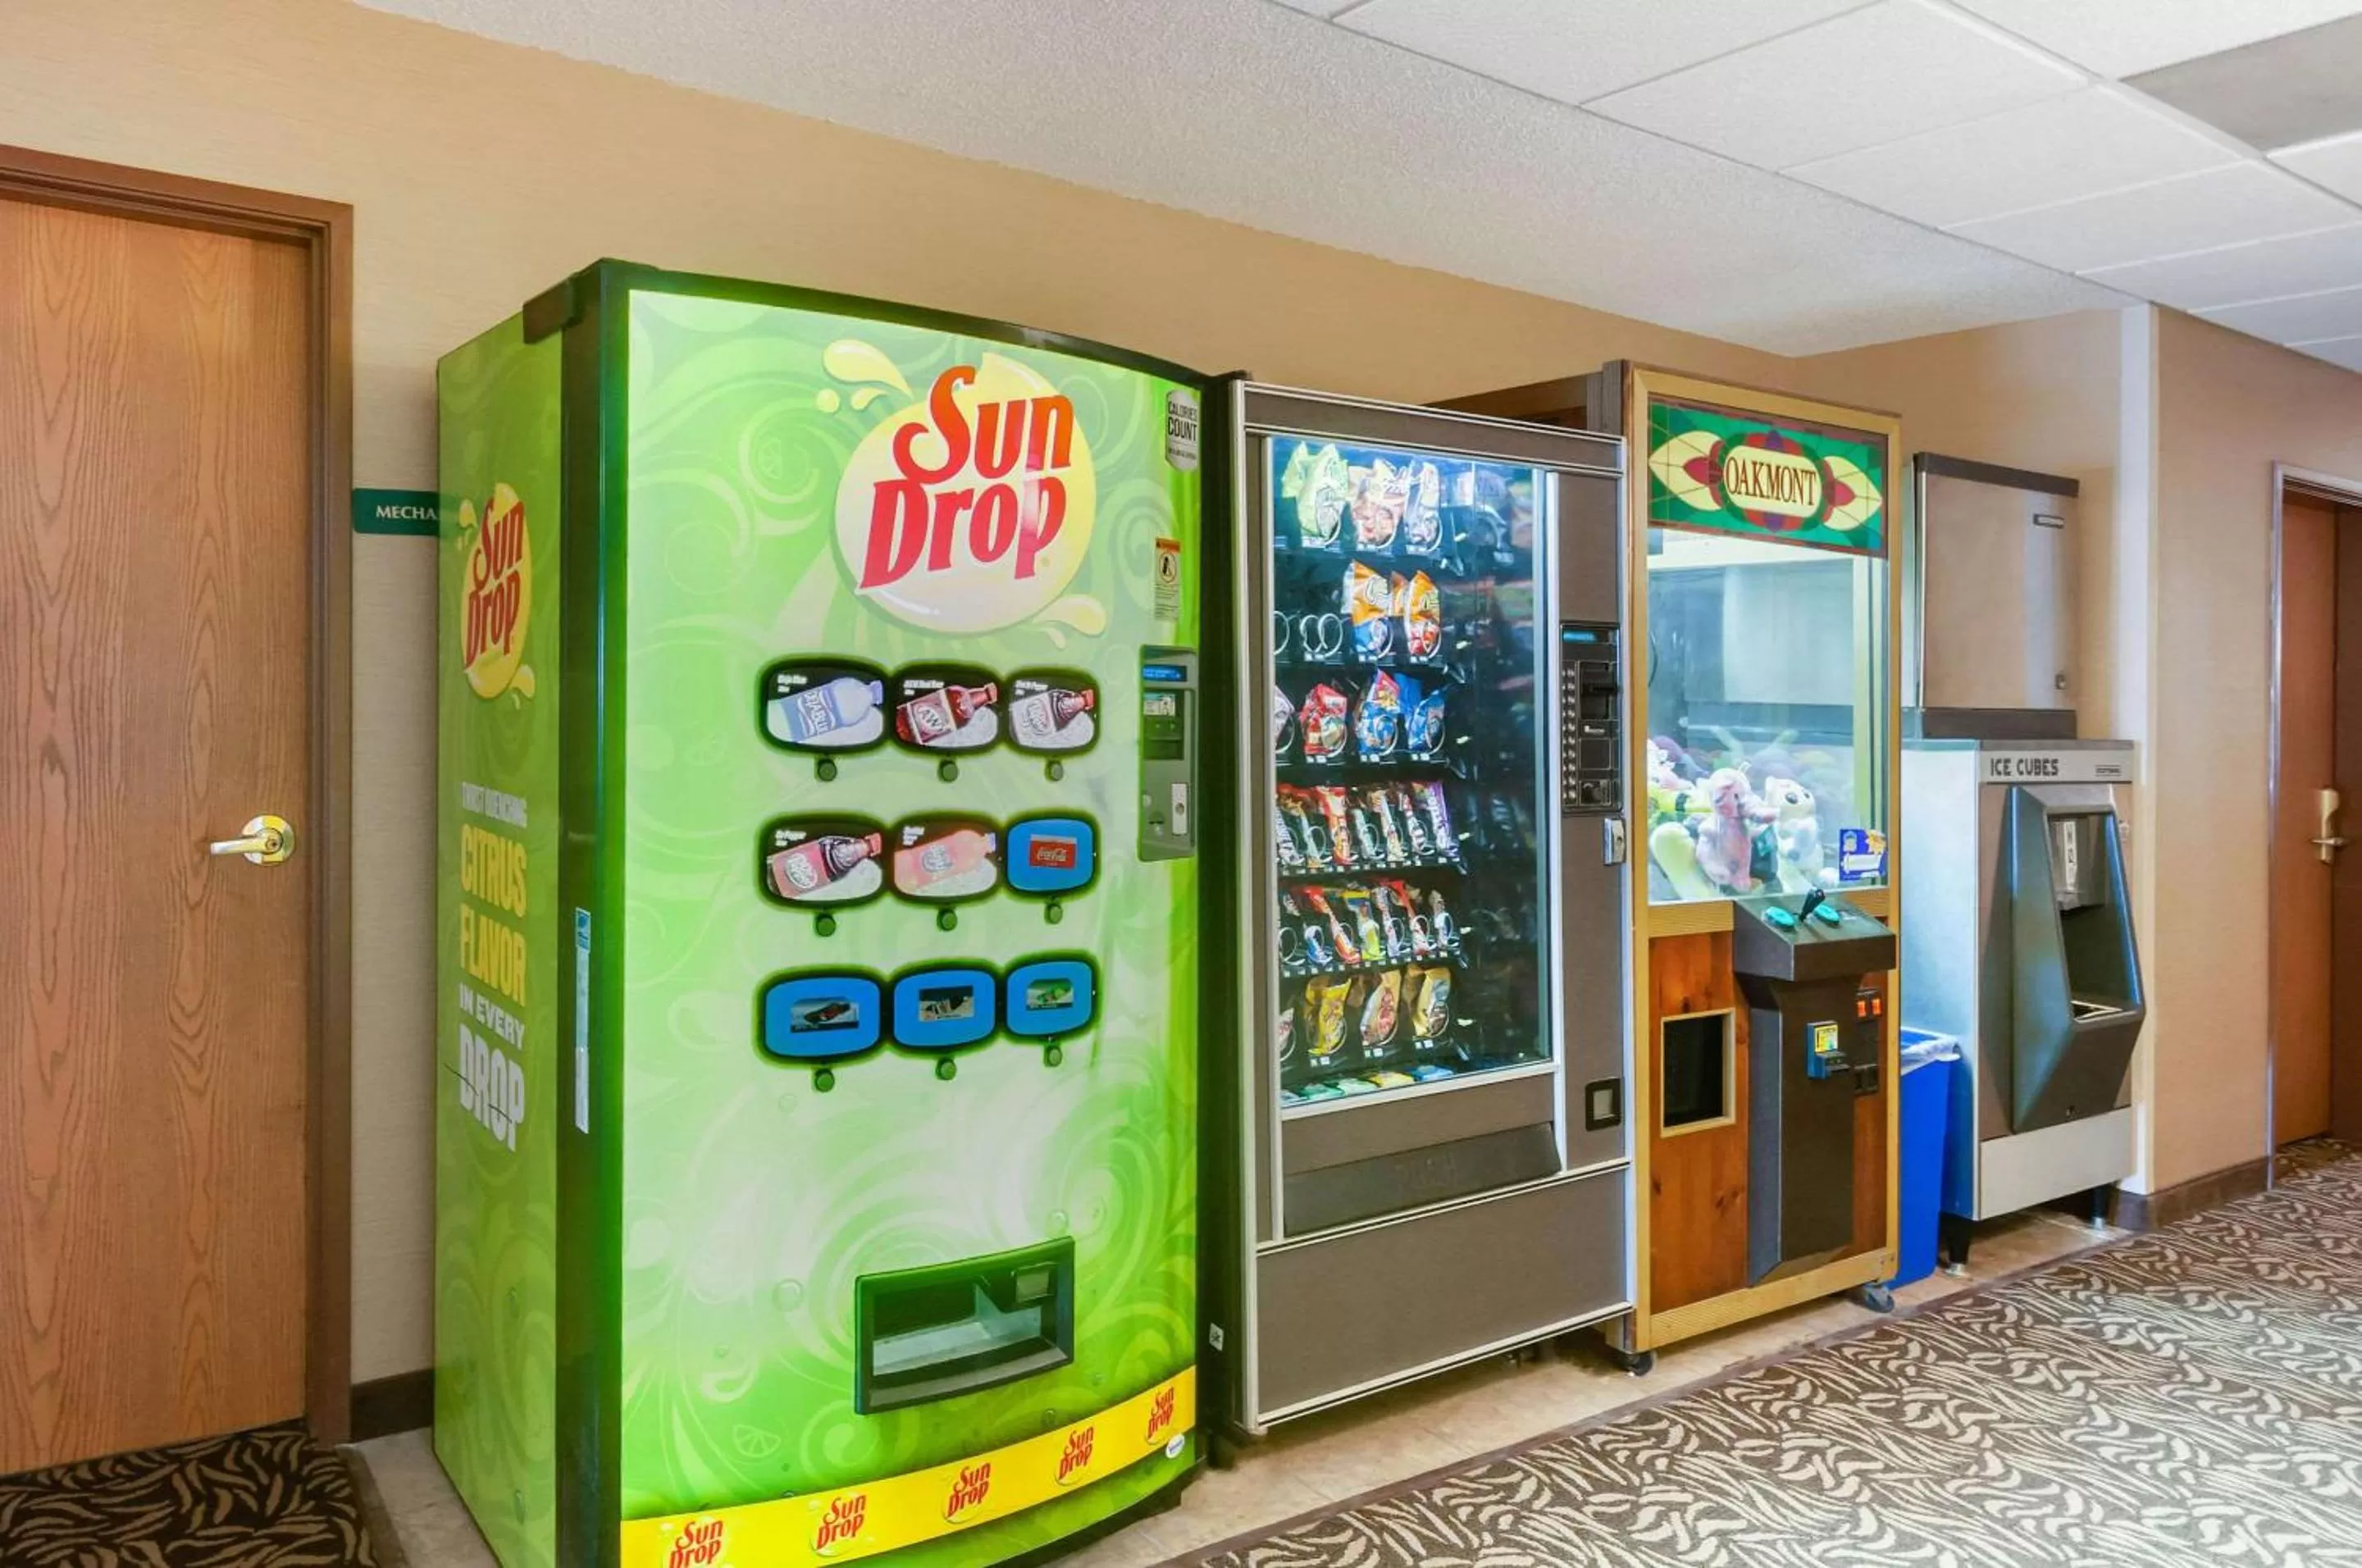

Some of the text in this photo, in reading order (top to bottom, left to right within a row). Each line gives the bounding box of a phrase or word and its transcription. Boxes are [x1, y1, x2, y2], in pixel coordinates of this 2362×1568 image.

[892, 366, 1074, 485] Sun
[1168, 417, 1197, 441] COUNT
[1725, 456, 1817, 506] OAKMONT
[376, 505, 440, 521] MECHA
[473, 496, 525, 590] Sun
[859, 476, 1067, 590] Drop
[464, 570, 521, 670] Drop
[1990, 757, 2059, 777] ICE CUBES
[461, 823, 527, 918] CITRUS
[460, 902, 527, 1007] FLAVOR
[459, 982, 526, 1051] IN EVERY
[459, 1023, 526, 1153] DROP
[1064, 1426, 1094, 1455] Sun
[953, 1462, 992, 1493] Sun
[1058, 1443, 1092, 1481] Drop
[823, 1493, 866, 1525] Sun
[947, 1480, 990, 1518] Drop
[675, 1520, 723, 1549] Sun
[815, 1514, 864, 1550] Drop
[668, 1538, 722, 1568] Drop
